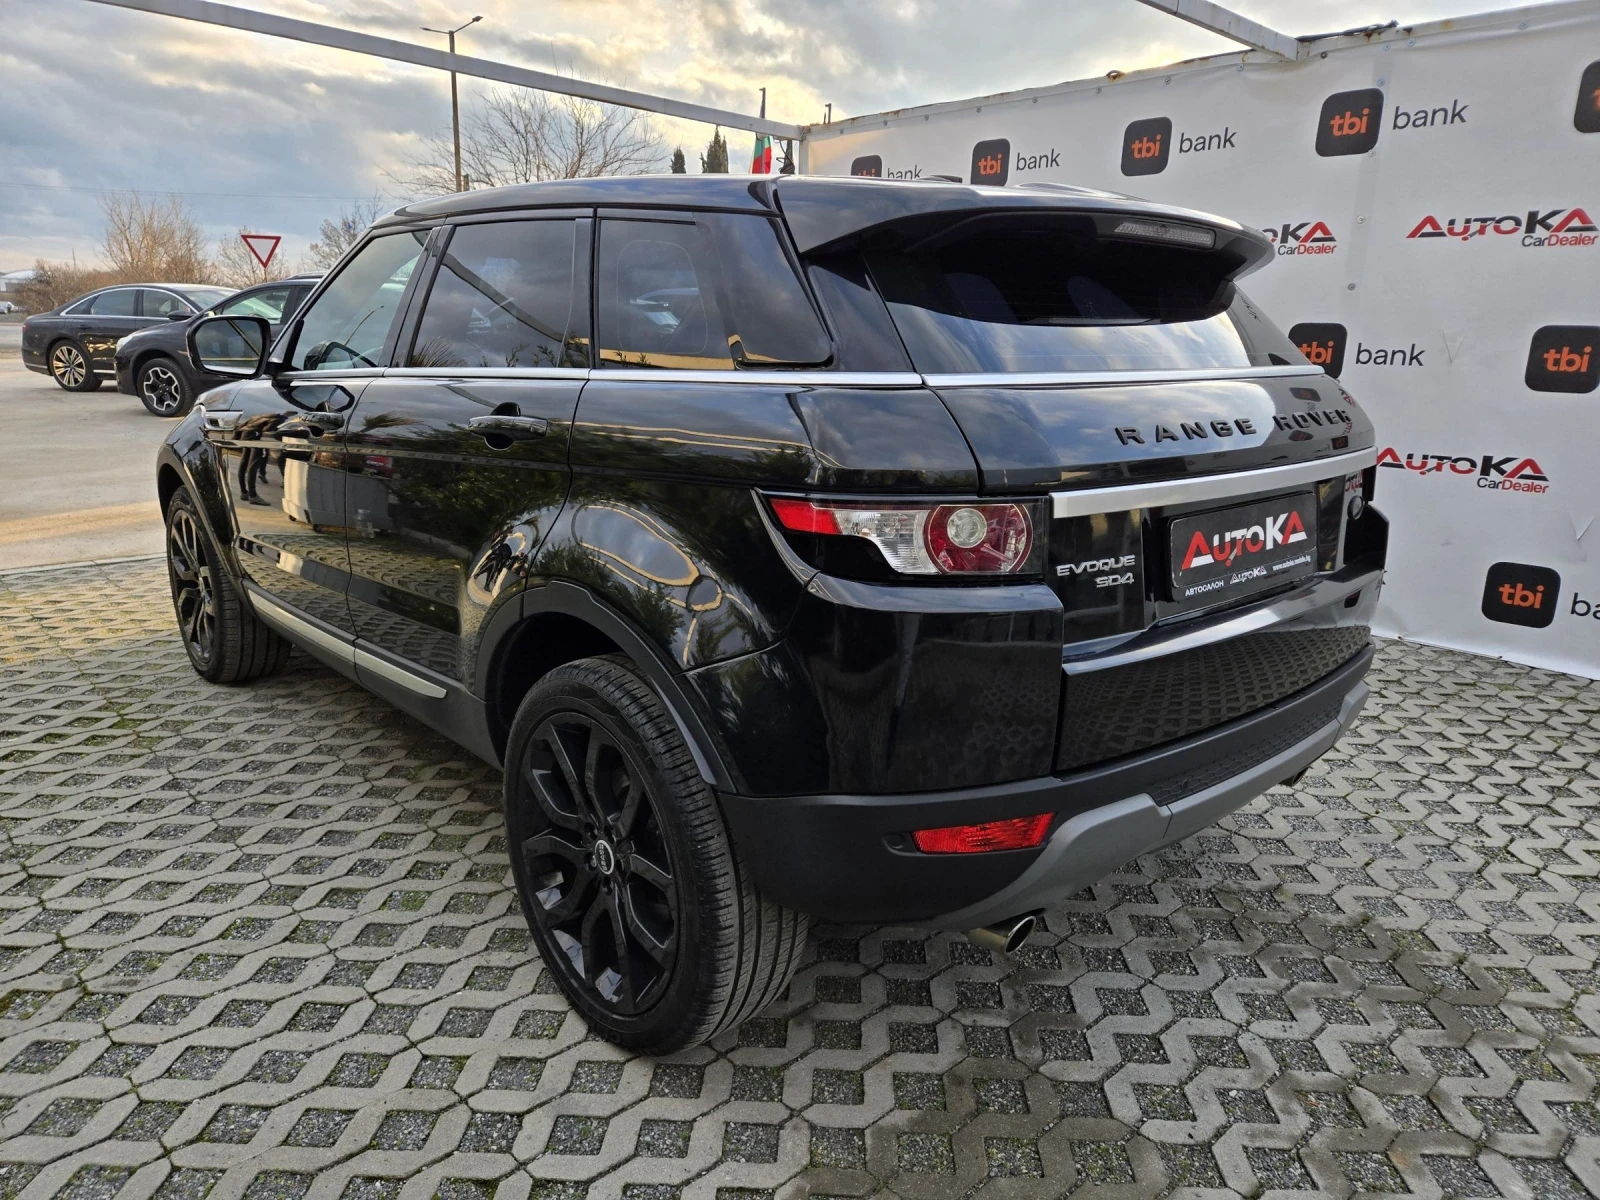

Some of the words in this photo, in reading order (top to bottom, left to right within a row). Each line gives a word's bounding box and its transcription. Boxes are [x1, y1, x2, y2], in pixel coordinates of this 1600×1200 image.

[1330, 108, 1370, 137] tbi
[1393, 99, 1469, 130] bank
[1131, 134, 1161, 159] tbi
[1179, 127, 1237, 154] bank
[978, 153, 1002, 175] tbi
[1016, 148, 1060, 171] bank
[1406, 208, 1599, 241] AUTOKA
[1277, 243, 1337, 256] CarDealer
[1521, 233, 1599, 248] CarDealer
[1299, 341, 1334, 365] tbi
[1355, 343, 1426, 366] bank
[1543, 345, 1592, 373] tbi
[1114, 417, 1257, 446] RANGE
[1272, 408, 1352, 432] ROVER
[1376, 447, 1549, 482] AUTOKA
[1476, 477, 1549, 494] CarDealer
[1181, 510, 1308, 570] AUTOKA
[1056, 554, 1136, 577] EVOQUE
[1094, 572, 1135, 588] SD4
[1185, 580, 1225, 597] АВТОСАЛОН
[1498, 583, 1545, 609] tbi
